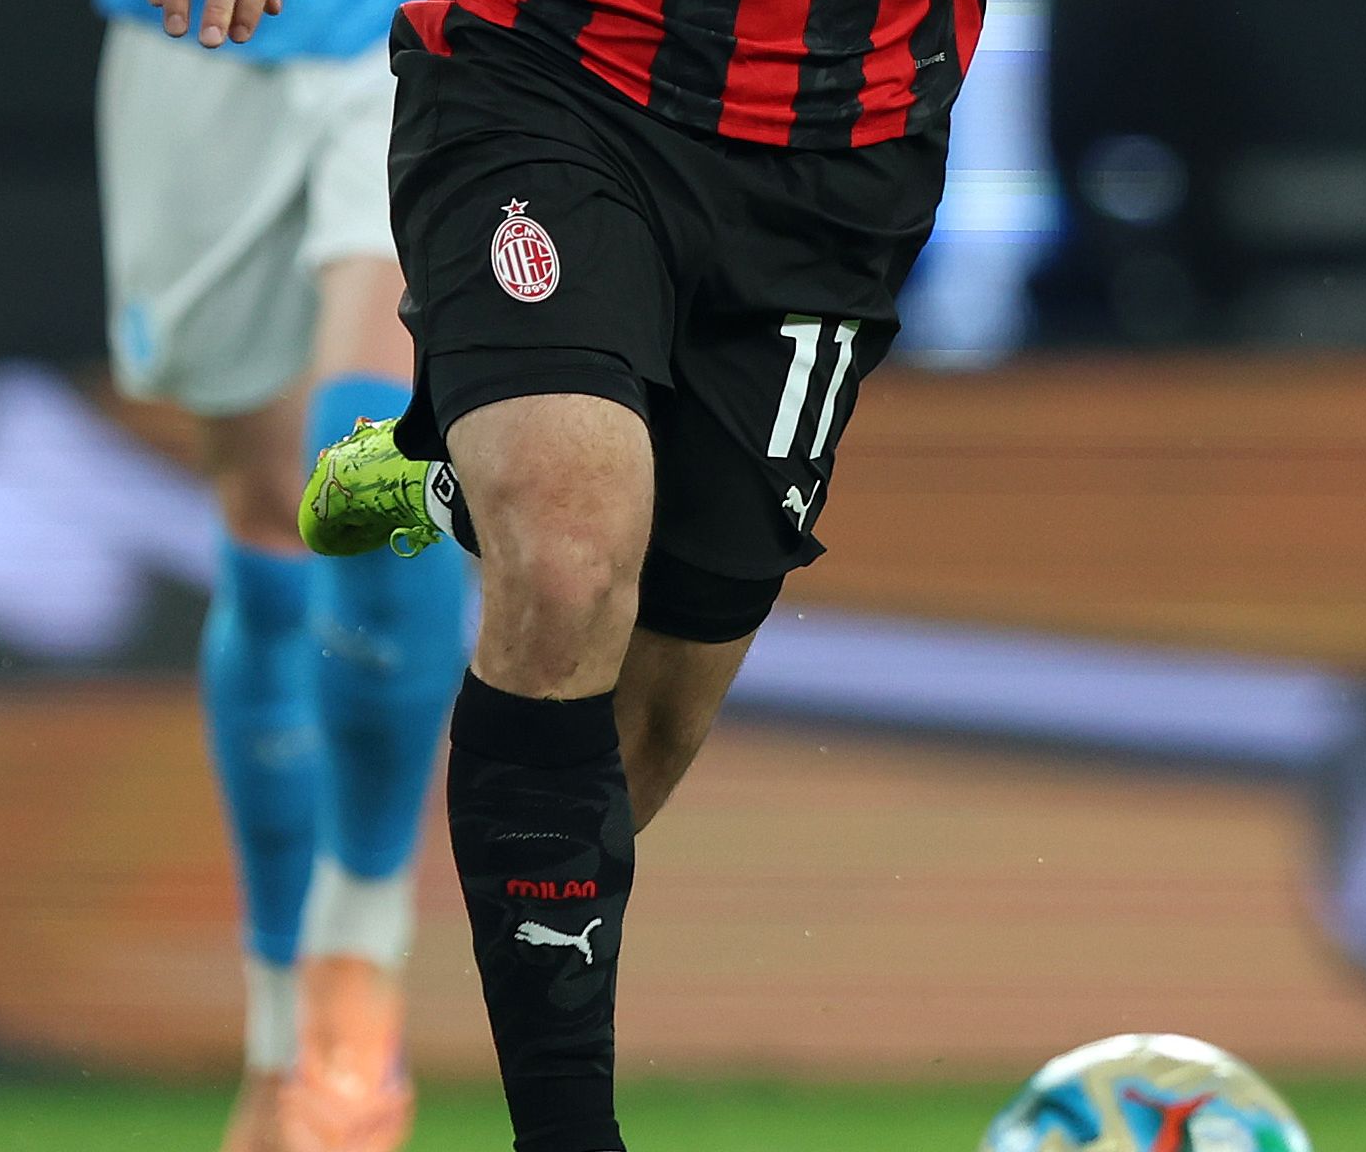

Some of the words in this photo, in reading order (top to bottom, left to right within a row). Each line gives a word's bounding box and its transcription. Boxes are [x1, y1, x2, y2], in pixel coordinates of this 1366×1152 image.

[502, 224, 538, 246] ACM
[517, 283, 548, 295] 1899
[767, 313, 861, 460] 11
